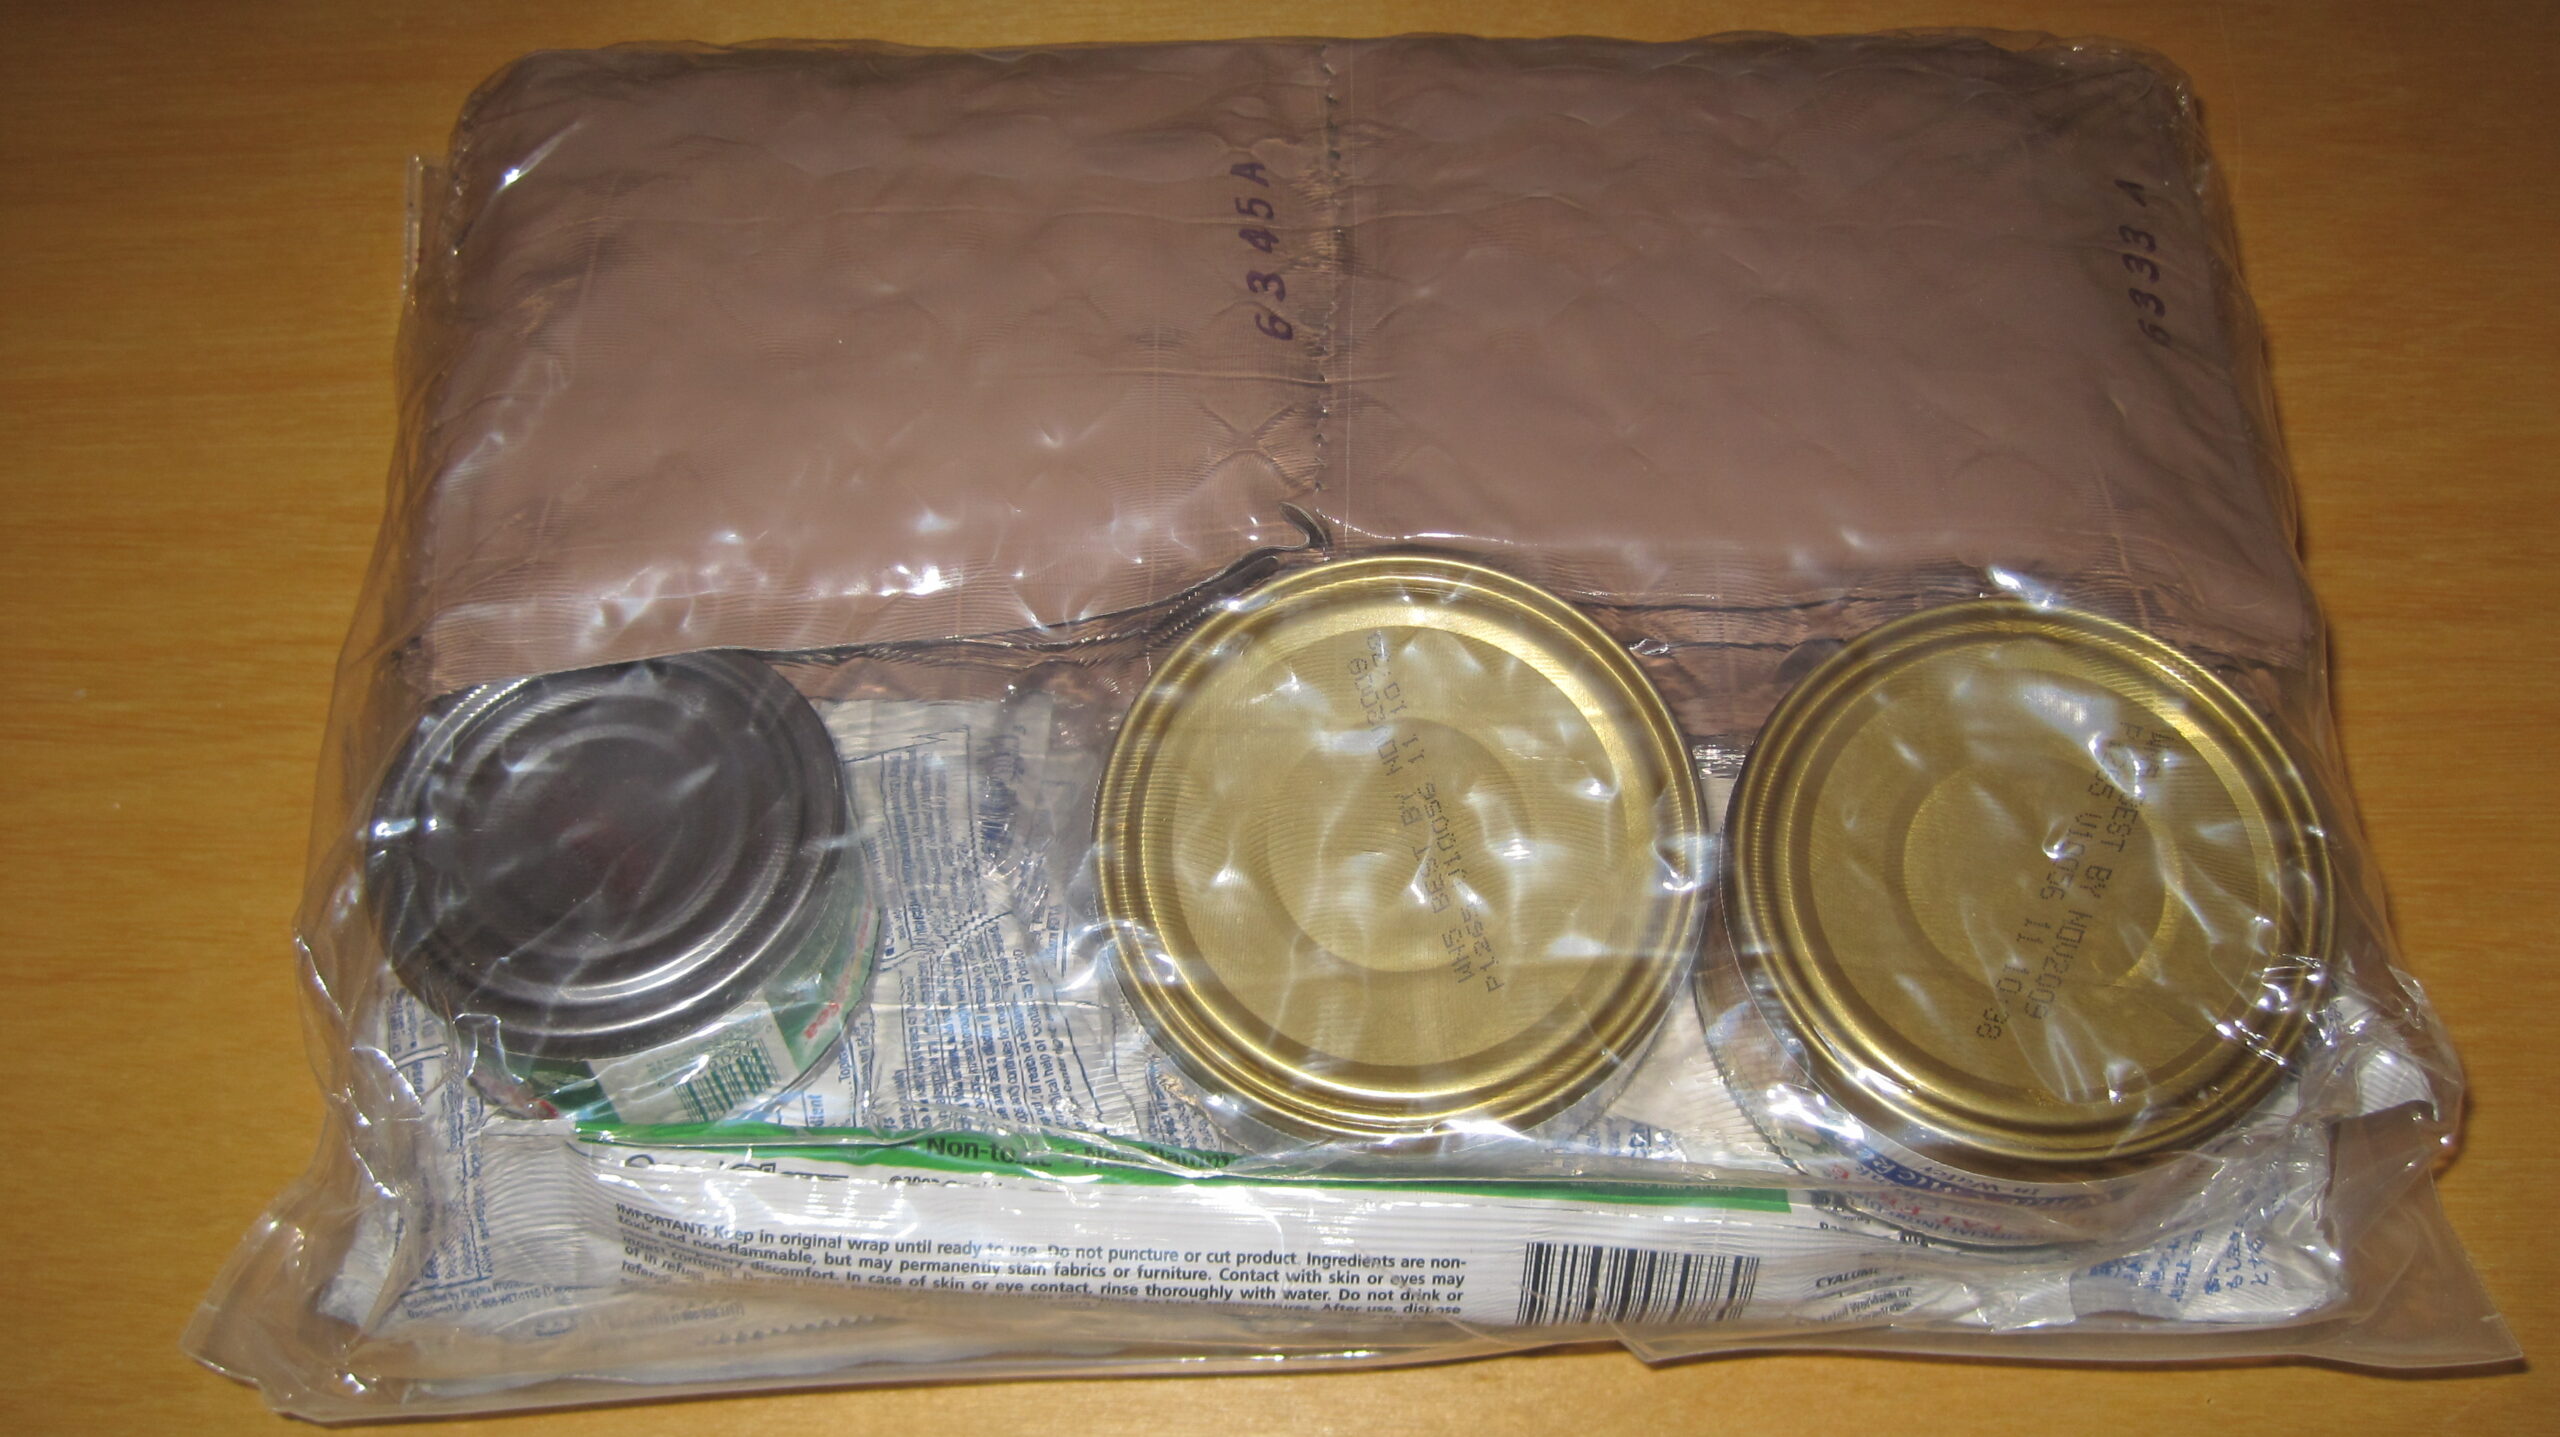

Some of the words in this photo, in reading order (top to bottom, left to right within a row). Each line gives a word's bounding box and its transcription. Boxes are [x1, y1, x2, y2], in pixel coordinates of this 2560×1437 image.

[1401, 733, 1426, 765] 11
[1394, 790, 1423, 827] BY
[1411, 844, 1451, 914] BEST
[2080, 864, 2113, 900] BY
[2015, 917, 2052, 946] 11
[2023, 908, 2093, 1021] NOV2009
[1023, 1056, 1041, 1086] reach
[1039, 1053, 1054, 1075] help
[616, 1202, 709, 1238] IMPORTANT:
[759, 1228, 775, 1244] in
[780, 1232, 842, 1250] original
[847, 1239, 890, 1255] wrap
[895, 1239, 932, 1253] until
[937, 1240, 982, 1259] ready
[1047, 1244, 1070, 1258] Do
[1075, 1245, 1103, 1259] not
[1108, 1248, 1179, 1263] puncture
[1184, 1252, 1202, 1264] or
[1206, 1251, 1231, 1264] cut
[1306, 1251, 1396, 1270] Ingredients
[1400, 1257, 1426, 1269] are
[1430, 1257, 1467, 1269] non-
[658, 1229, 686, 1243] and
[693, 1237, 817, 1266] non-flammable,
[824, 1251, 852, 1267] but
[858, 1256, 893, 1273] may
[899, 1259, 1001, 1277] permanently
[1007, 1261, 1047, 1276] stain
[1053, 1261, 1107, 1278] fabrics
[1113, 1266, 1131, 1278] or
[1137, 1264, 1212, 1281] furniture.
[1218, 1267, 1280, 1283] Contact
[1285, 1269, 1322, 1284] with
[1328, 1270, 1360, 1285] skin
[1366, 1274, 1384, 1285] or
[1390, 1273, 1426, 1289] eyes
[1431, 1273, 1466, 1289] may
[751, 1260, 840, 1281] discomfort.
[846, 1271, 861, 1283] In
[868, 1274, 902, 1286] case
[908, 1275, 927, 1287] of
[932, 1276, 965, 1290] skin
[971, 1279, 989, 1291] or
[995, 1281, 1024, 1294] eye
[1100, 1282, 1139, 1297] rinse
[1144, 1283, 1233, 1301] thoroughly
[1239, 1286, 1276, 1301] with
[1282, 1289, 1332, 1302] water.
[1338, 1289, 1360, 1302] Do
[1367, 1290, 1394, 1302] not
[1400, 1288, 1440, 1302] drink
[1446, 1291, 1464, 1303] or
